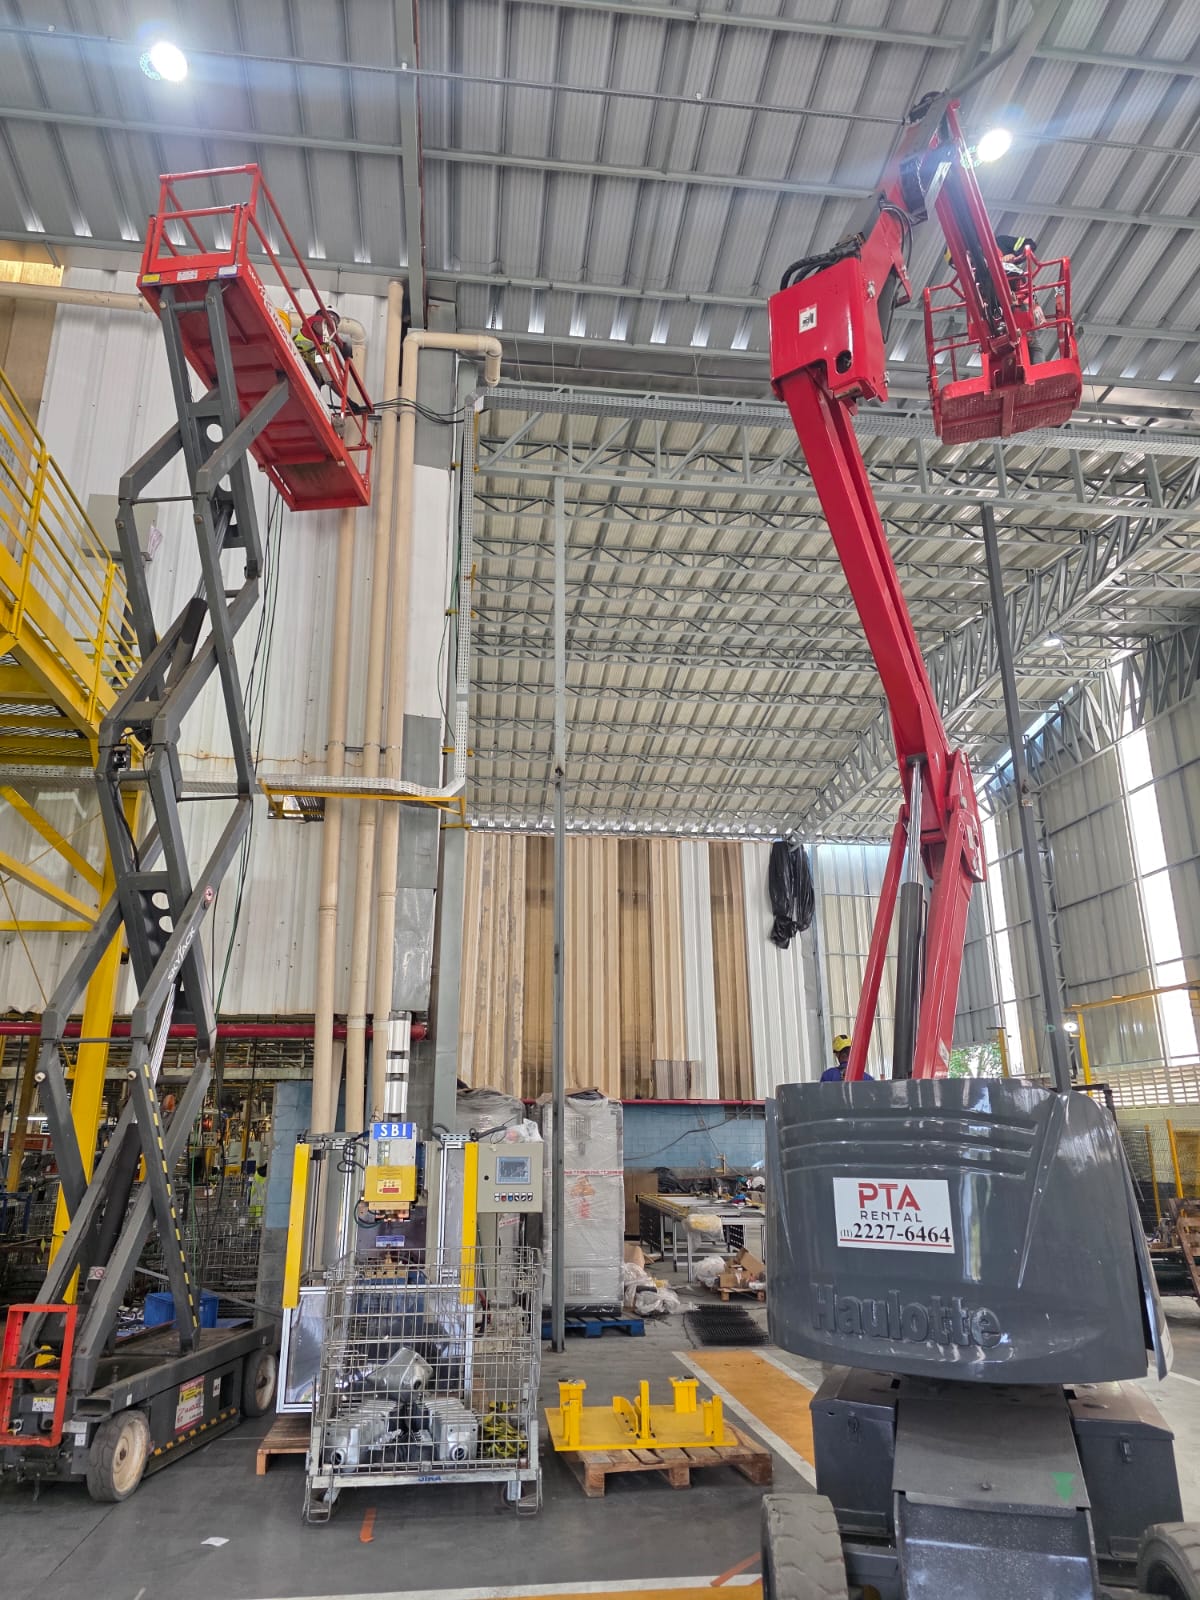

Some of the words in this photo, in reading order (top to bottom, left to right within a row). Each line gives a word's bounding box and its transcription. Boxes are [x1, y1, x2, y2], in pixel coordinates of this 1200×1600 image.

[380, 1124, 407, 1137] SBI
[858, 1183, 921, 1211] PTA
[860, 1210, 923, 1223] RENTAL
[810, 1283, 1002, 1348] Haulotte
